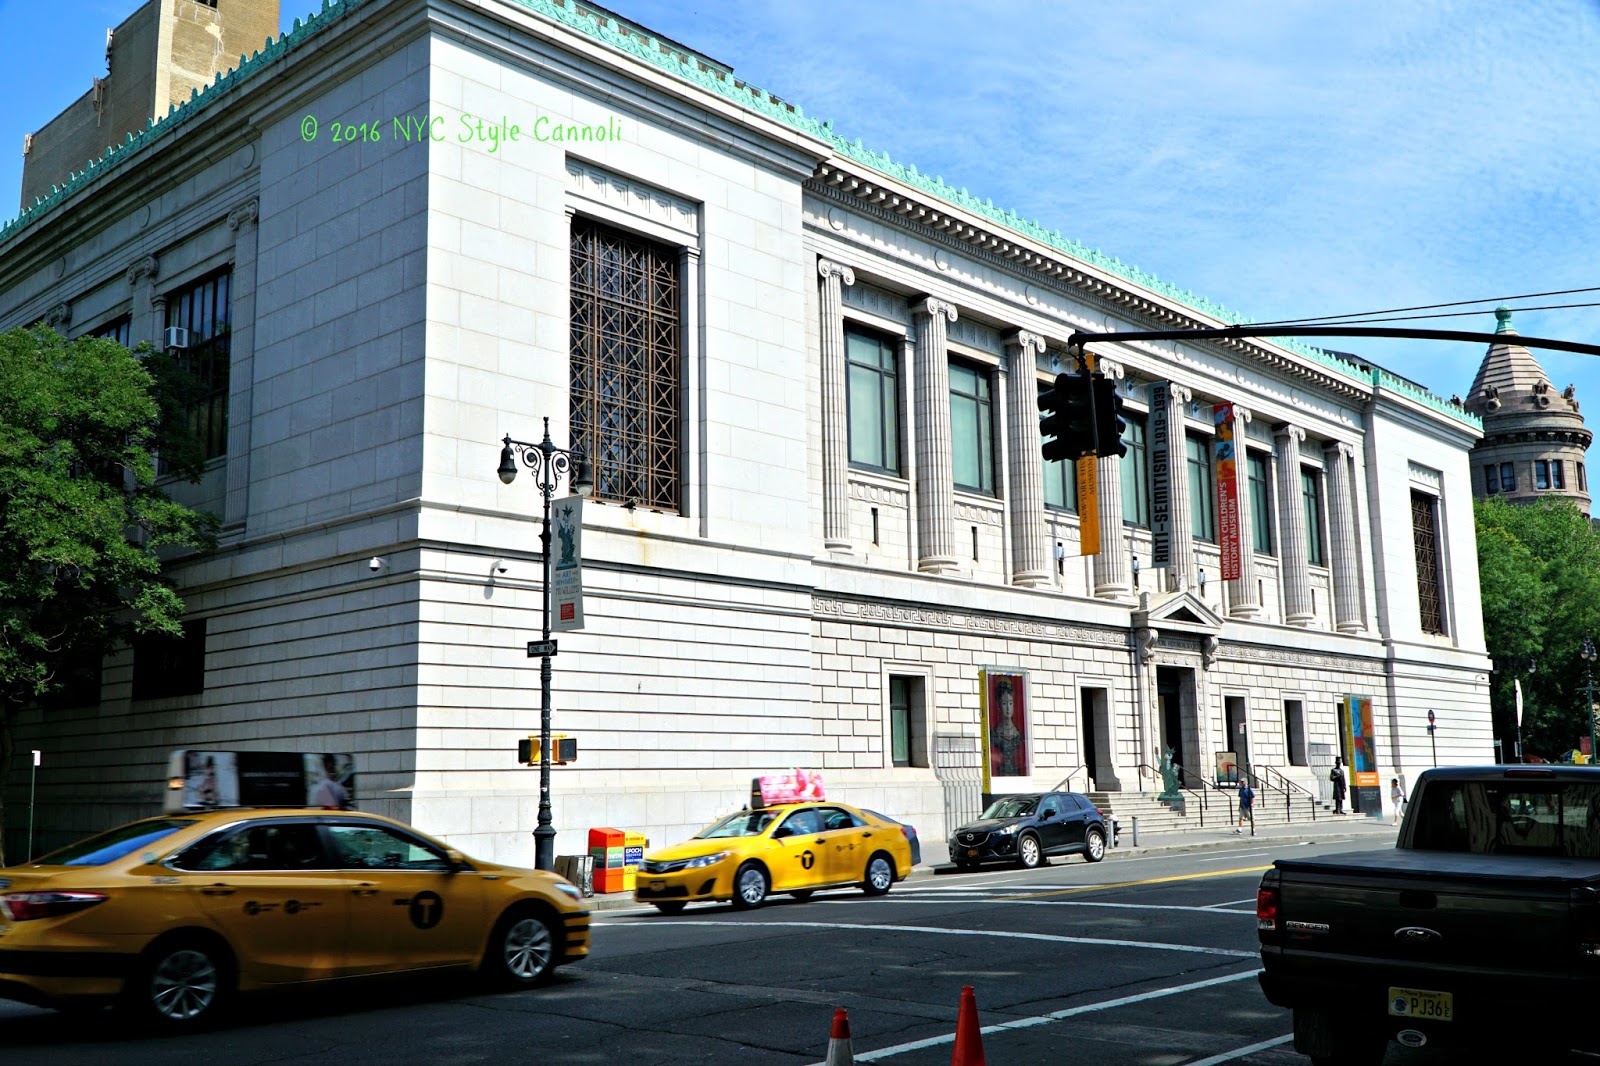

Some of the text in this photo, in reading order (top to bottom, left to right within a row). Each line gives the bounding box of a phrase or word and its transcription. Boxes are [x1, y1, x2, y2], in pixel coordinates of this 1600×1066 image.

[1087, 458, 1095, 495] MUSEUM
[1153, 386, 1169, 563] ANTI-SEMITISM 1919-1939
[1220, 482, 1231, 579] DIMENNA CHILDREN'S
[1229, 499, 1239, 578] HISTORY MUSEUM
[531, 645, 540, 653] ONE
[803, 853, 812, 867] T
[418, 899, 435, 924] T
[1287, 921, 1328, 931] RANGER
[1411, 997, 1443, 1017] PJ36
